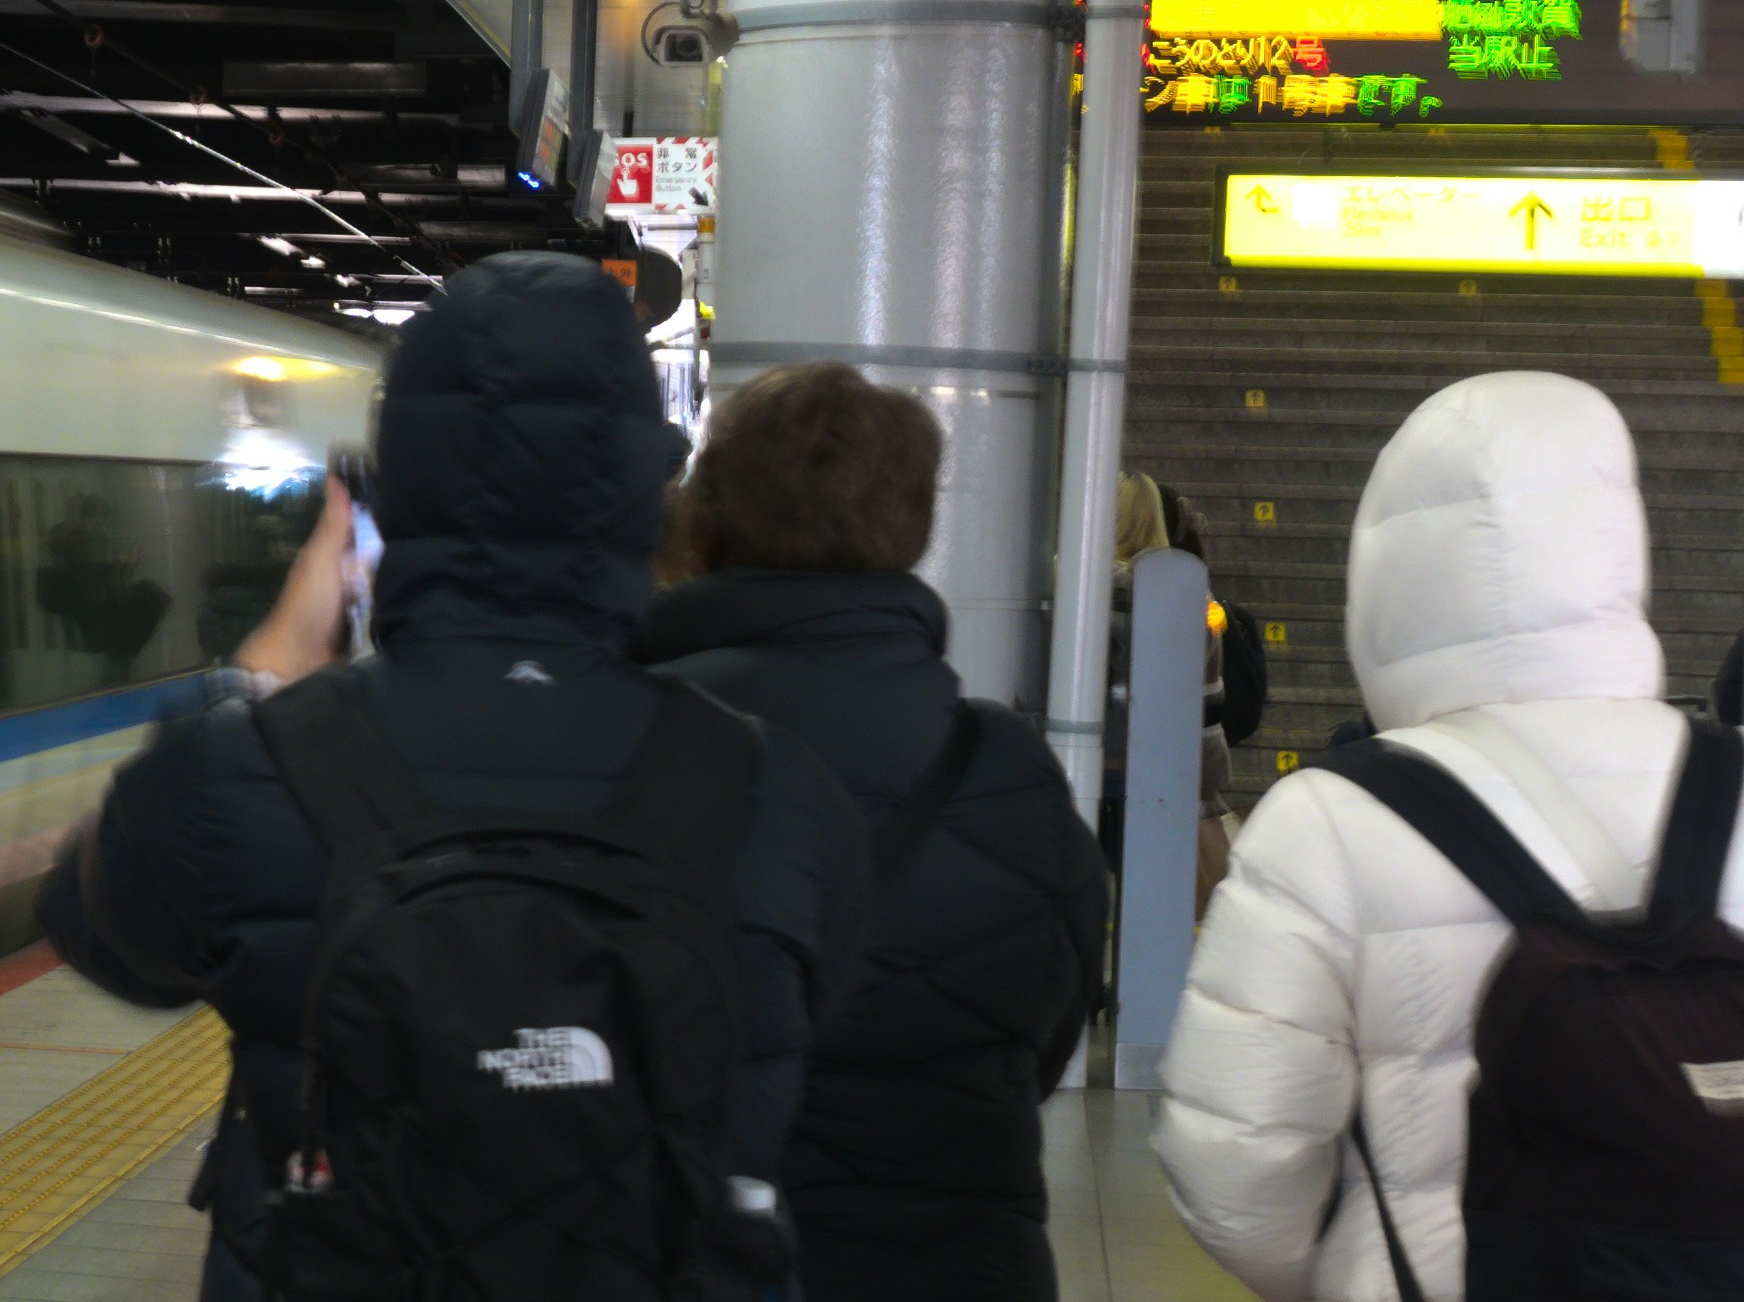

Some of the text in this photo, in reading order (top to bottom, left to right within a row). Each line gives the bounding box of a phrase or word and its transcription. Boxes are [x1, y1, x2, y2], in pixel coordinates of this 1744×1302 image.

[657, 161, 698, 173] ボタン
[1581, 195, 1651, 223] 出口
[1580, 228, 1629, 247] Exit
